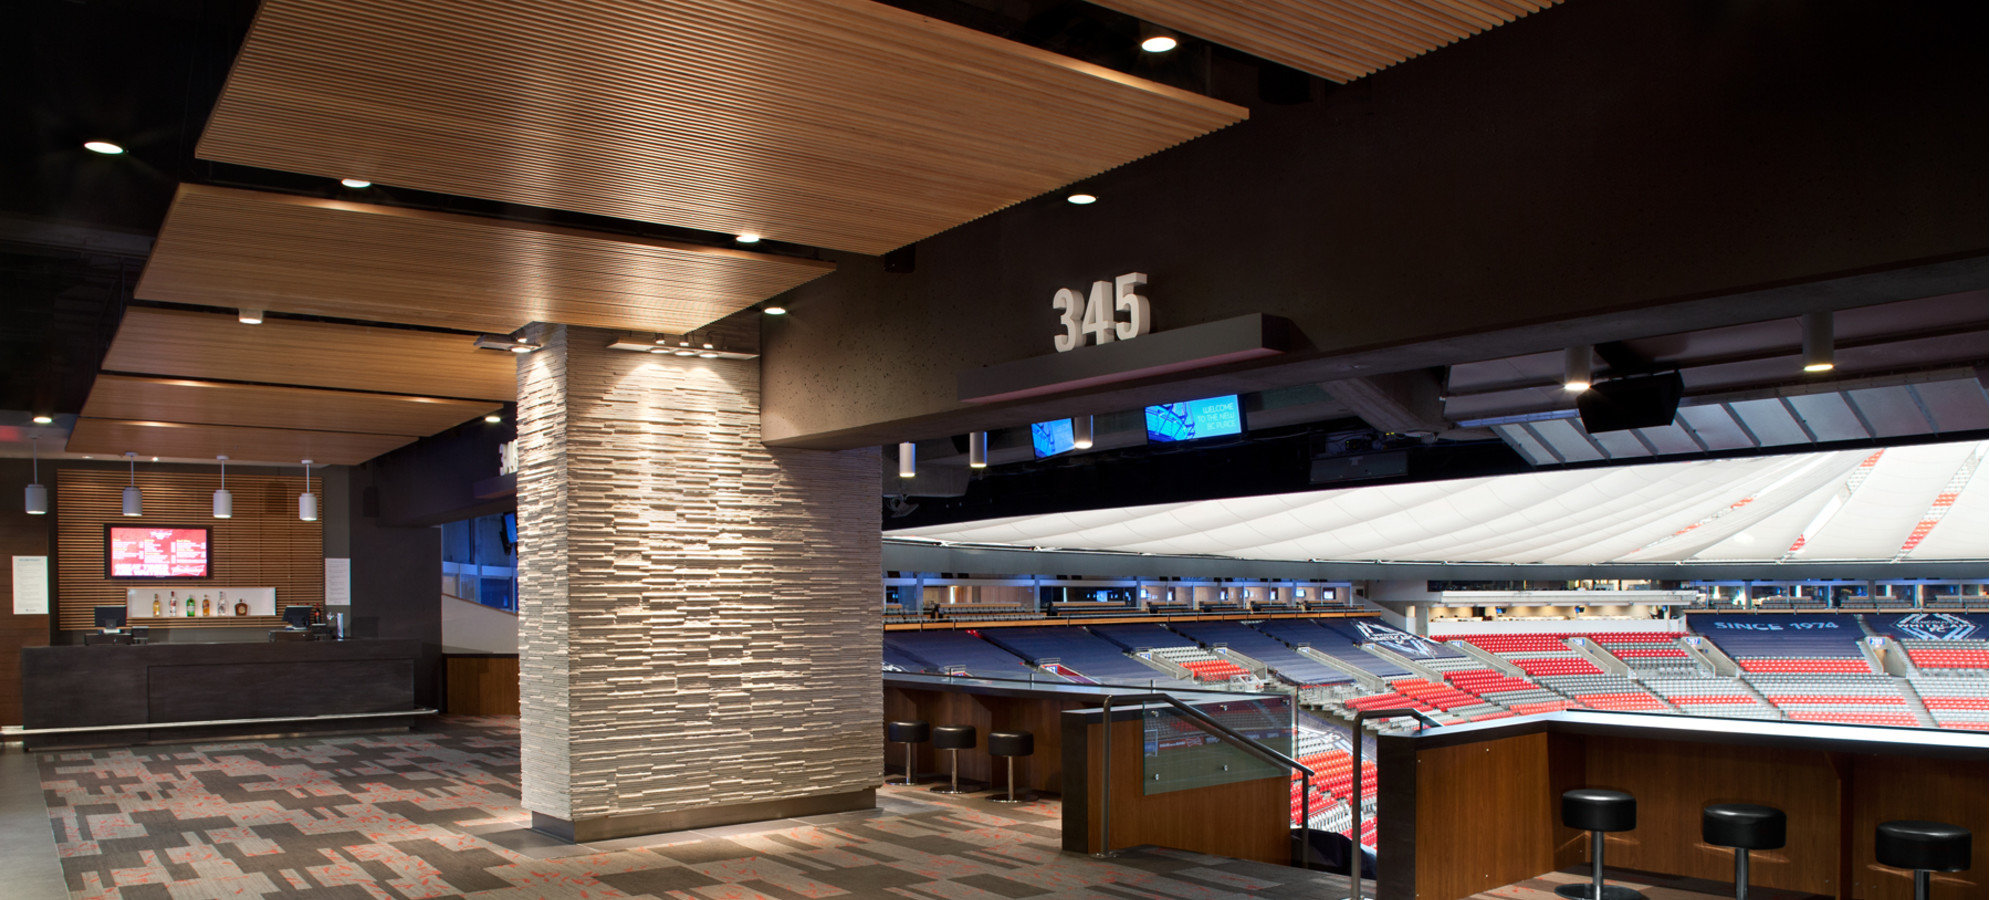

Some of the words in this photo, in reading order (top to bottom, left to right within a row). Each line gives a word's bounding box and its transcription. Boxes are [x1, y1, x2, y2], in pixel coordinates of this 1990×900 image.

[1052, 272, 1150, 353] 345
[1203, 402, 1234, 414] WELCOME
[1197, 415, 1206, 423] TO
[1207, 413, 1218, 422] THE
[1219, 411, 1234, 420] NEW
[1216, 420, 1236, 429] PLACE
[1714, 621, 1784, 631] SINCE
[1789, 621, 1839, 630] 1974
